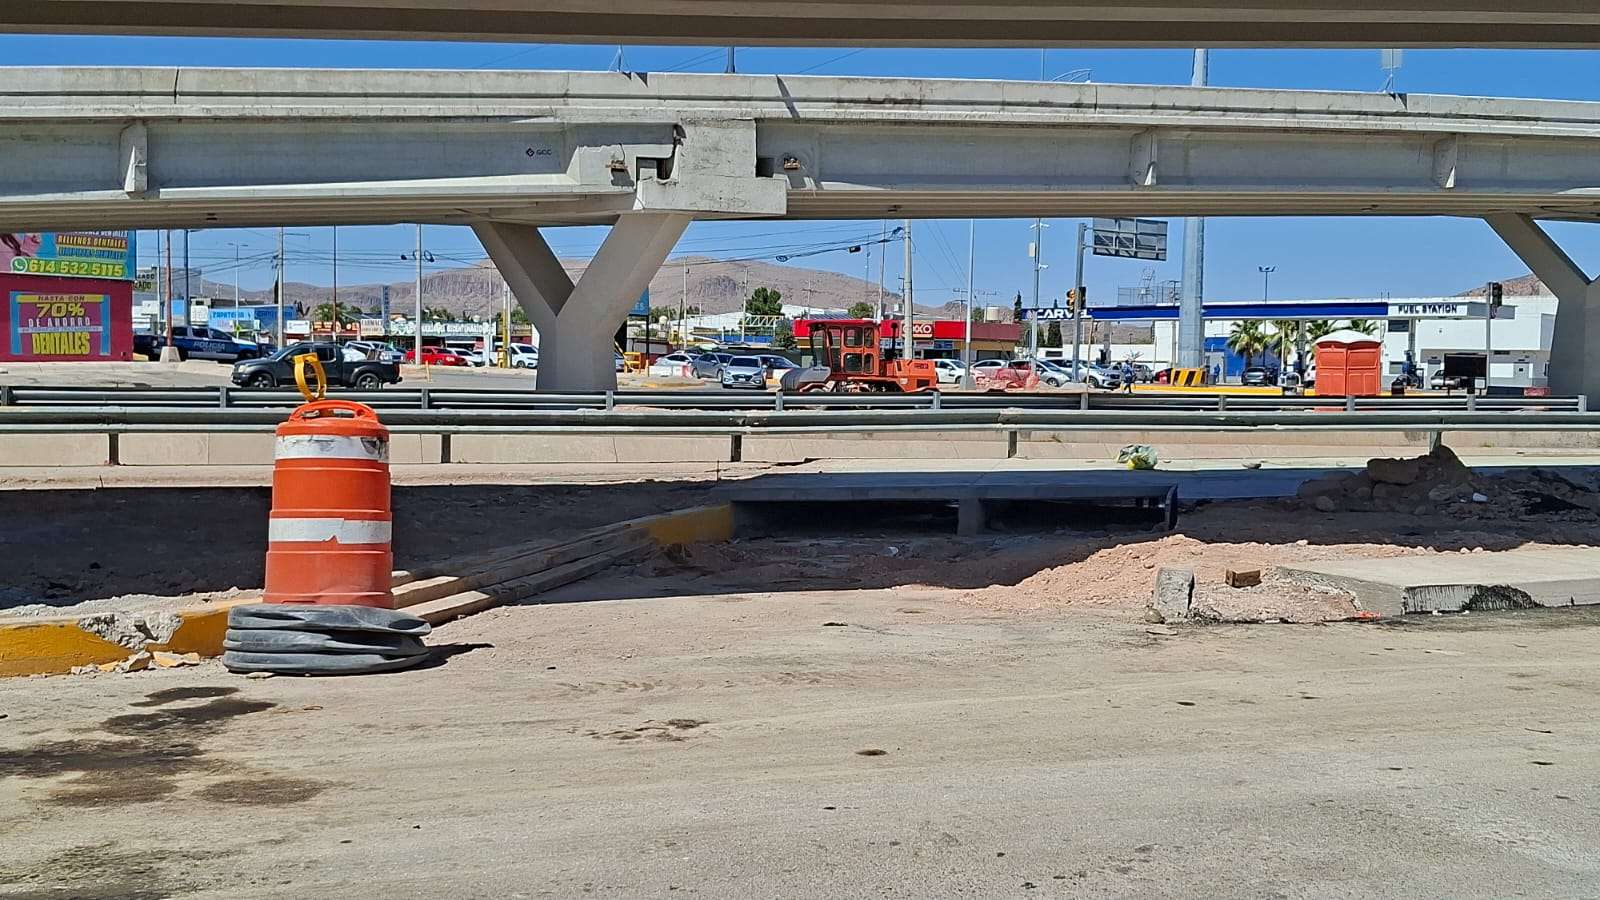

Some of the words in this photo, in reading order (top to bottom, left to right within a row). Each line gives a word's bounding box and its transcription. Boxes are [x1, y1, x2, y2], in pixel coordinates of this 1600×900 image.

[29, 259, 56, 273] 614
[60, 261, 88, 275] 532
[91, 264, 123, 277] 5115
[36, 302, 87, 318] 70%
[1398, 305, 1420, 314] FUEL
[1422, 304, 1457, 314] STATION
[28, 318, 41, 328] DE
[47, 317, 91, 327] AHORRO
[31, 332, 91, 355] DENTALES
